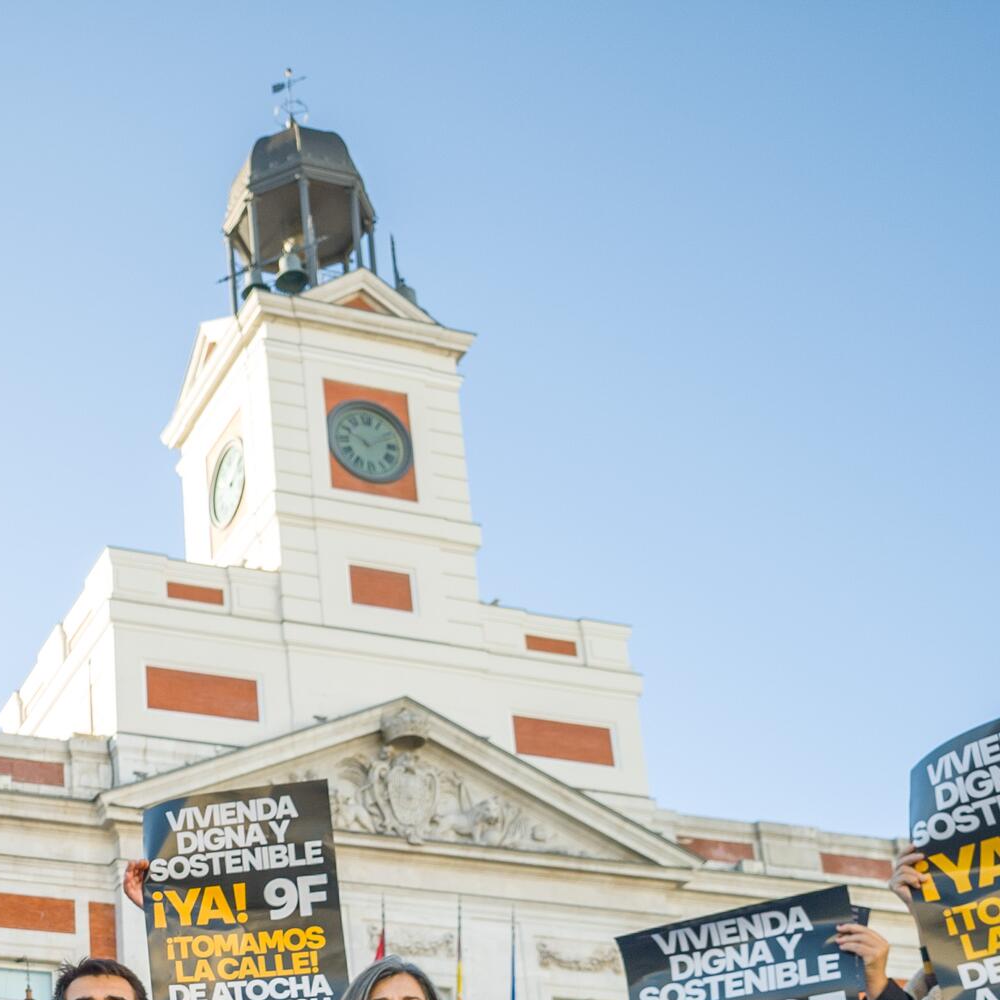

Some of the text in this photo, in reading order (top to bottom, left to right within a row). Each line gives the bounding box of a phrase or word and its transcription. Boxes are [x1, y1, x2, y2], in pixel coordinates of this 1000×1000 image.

[926, 732, 1000, 786] VIVIE
[166, 795, 298, 832] VIVIENDA
[912, 794, 1000, 848] SOST
[176, 820, 290, 855] DIGNA Y
[150, 840, 324, 882] SOSTENIBLE
[152, 874, 328, 928] ¡YA! 9F
[166, 926, 326, 960] ¡TOMAMOS
[651, 906, 813, 955] VIVIENDA
[175, 951, 319, 983] LA CALLE!
[669, 933, 802, 981] DIGNA Y
